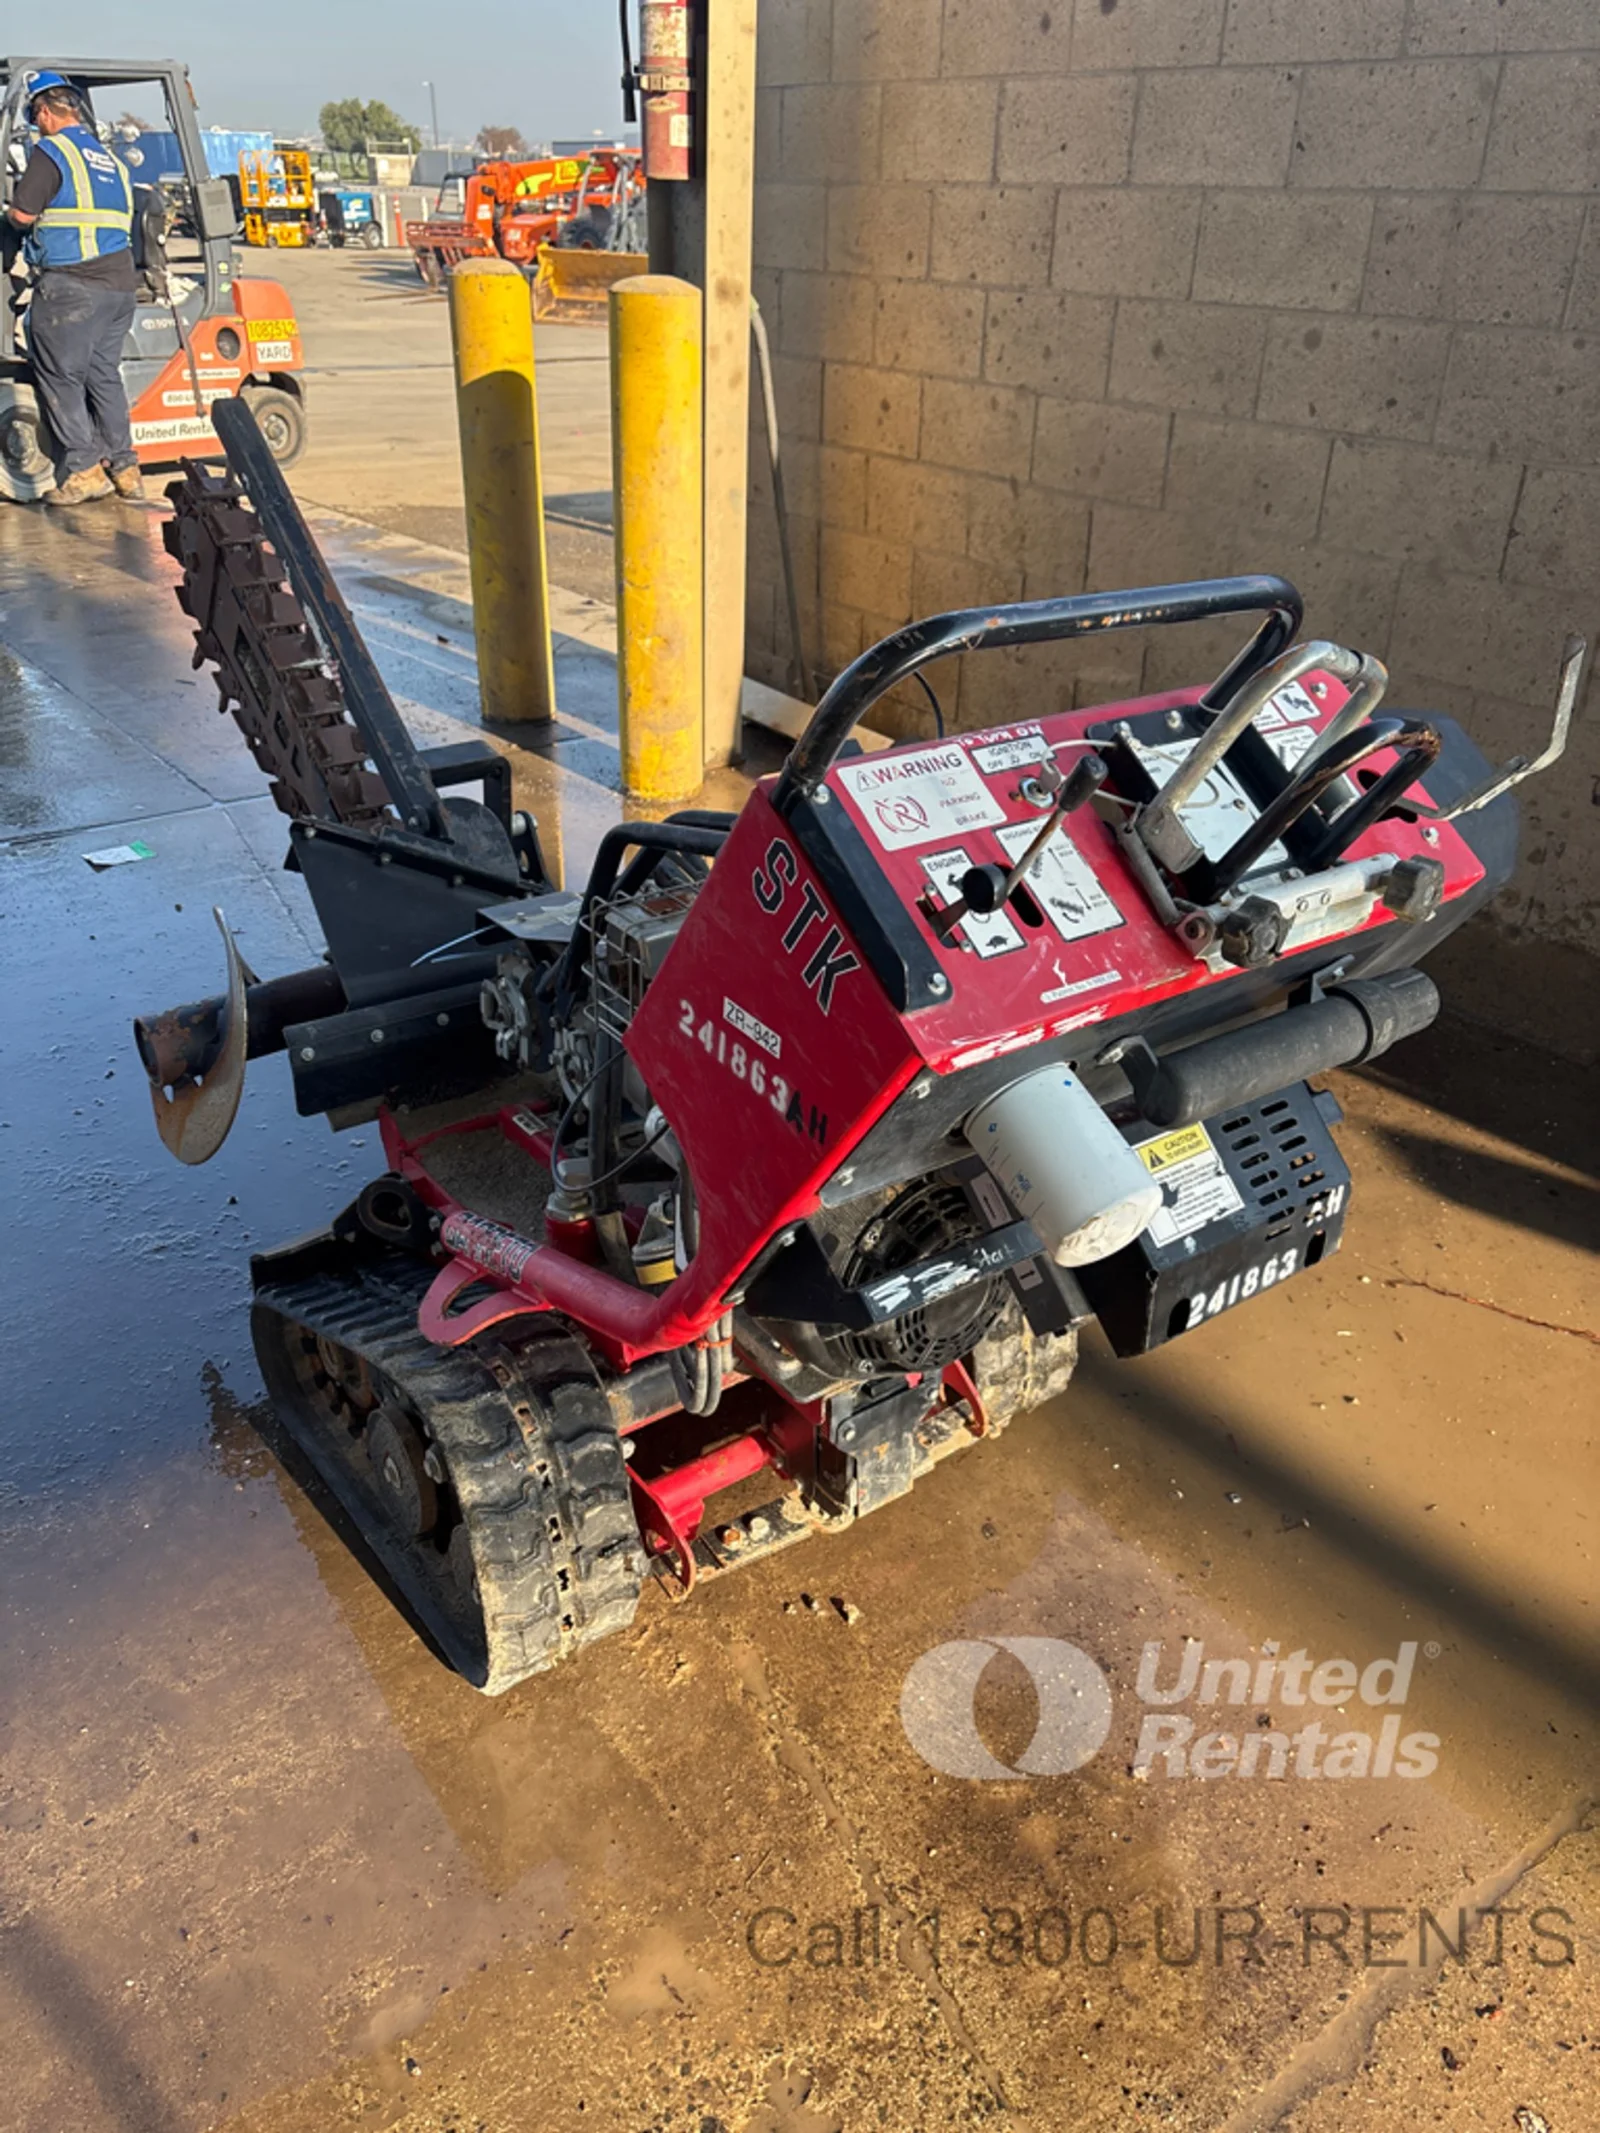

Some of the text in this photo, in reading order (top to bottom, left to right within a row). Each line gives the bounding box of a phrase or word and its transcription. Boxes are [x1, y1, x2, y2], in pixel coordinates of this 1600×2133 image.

[257, 345, 291, 360] YARD
[135, 421, 213, 441] United Renta
[872, 752, 962, 784] WARNING
[939, 792, 981, 808] PARKING
[955, 811, 988, 826] BRAKE
[926, 853, 967, 872] ENGINE
[752, 837, 861, 1017] STK
[724, 1000, 780, 1056] ZR-942
[1163, 1131, 1198, 1151] CAUTION
[1185, 1248, 1298, 1329] 241863
